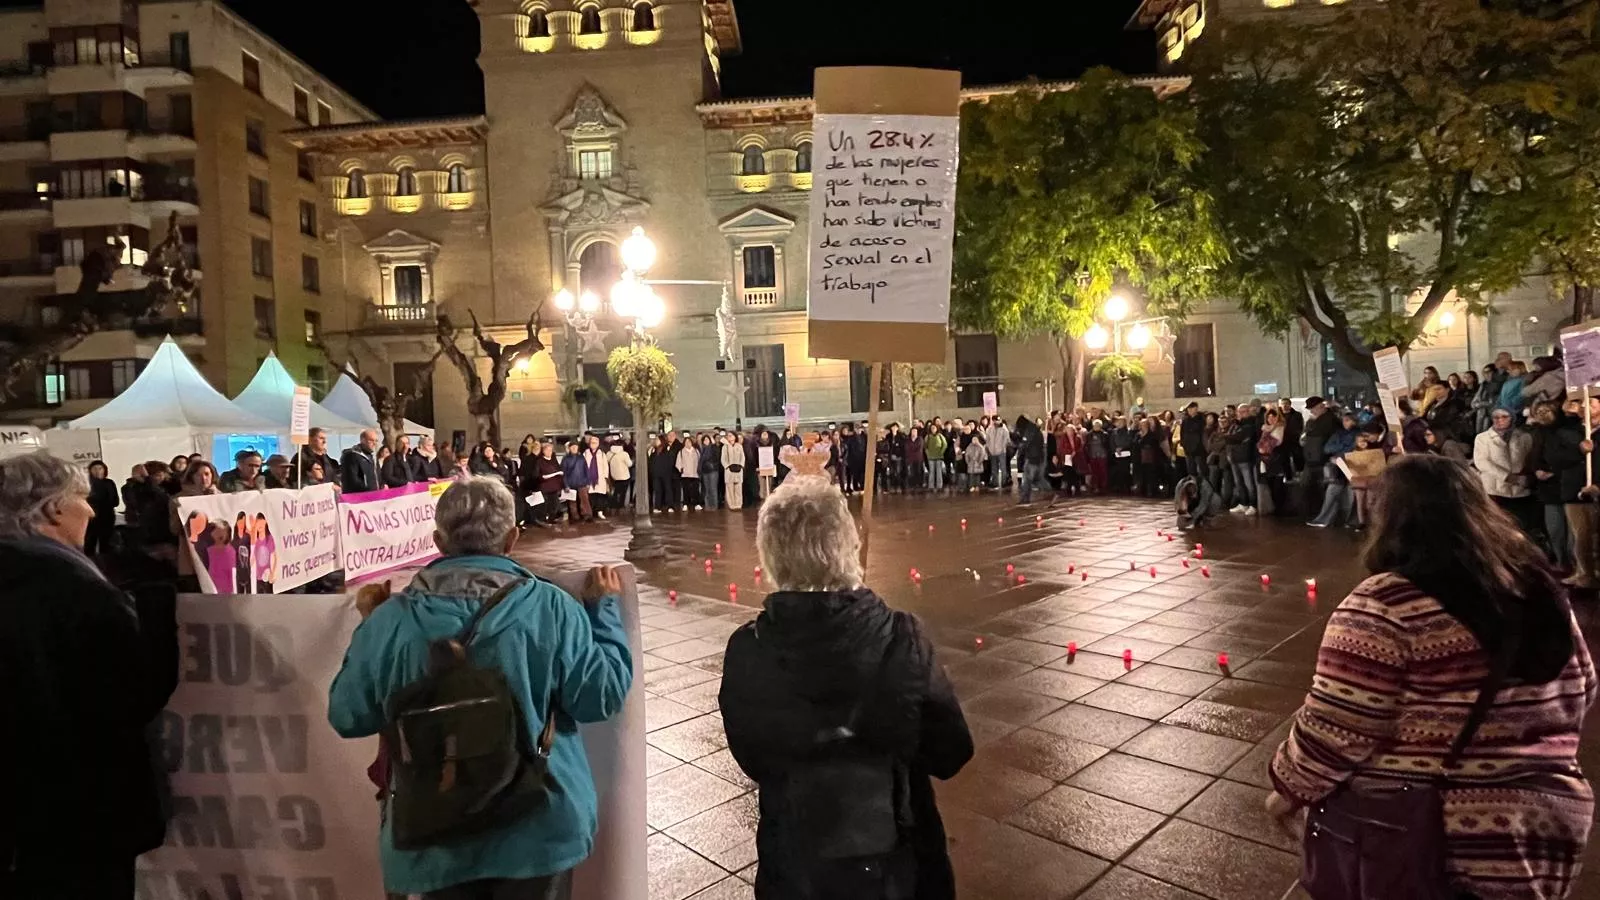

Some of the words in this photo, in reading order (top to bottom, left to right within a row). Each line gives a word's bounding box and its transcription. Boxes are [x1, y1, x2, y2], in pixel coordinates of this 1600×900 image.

[828, 130, 855, 151] Un
[825, 156, 846, 170] de
[852, 154, 873, 169] las
[880, 156, 940, 175] mujeres
[826, 178, 853, 196] que
[862, 172, 909, 188] tienen
[915, 178, 927, 187] o
[825, 194, 850, 208] han
[823, 212, 849, 228] han
[854, 209, 888, 226] sido
[820, 234, 842, 249] de
[849, 236, 907, 247] acoso
[890, 254, 908, 264] en
[915, 247, 932, 264] el
[820, 273, 888, 304] trabajo
[282, 500, 298, 520] Ni
[301, 502, 316, 517] una
[346, 509, 375, 536] NO
[372, 506, 401, 533] MÁS
[282, 528, 309, 549] vivas
[311, 528, 318, 548] y
[346, 544, 394, 572] CONTRA
[395, 538, 417, 560] LAS
[281, 561, 301, 579] nos
